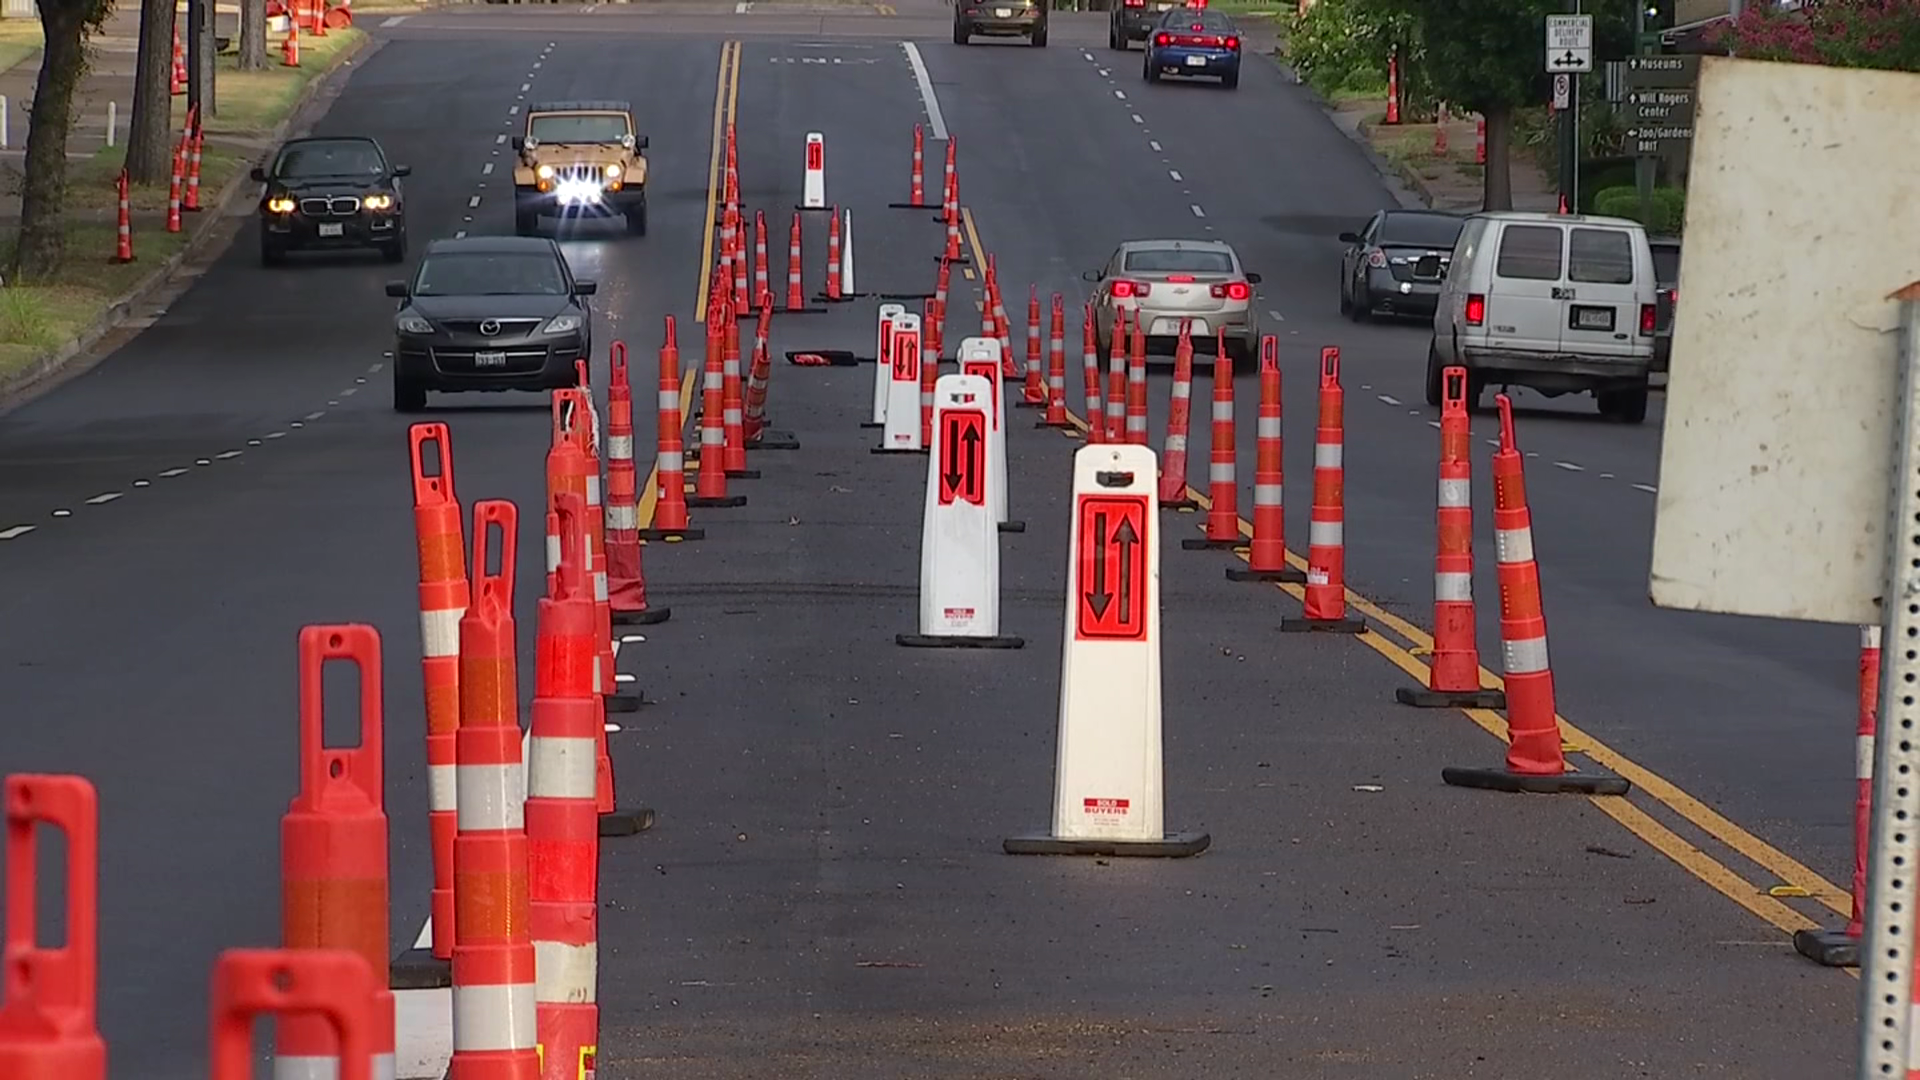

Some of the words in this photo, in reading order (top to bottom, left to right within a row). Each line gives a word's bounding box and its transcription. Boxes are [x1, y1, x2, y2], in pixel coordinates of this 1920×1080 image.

[1554, 28, 1584, 37] DELIVERY
[1639, 59, 1683, 69] Museums
[1639, 93, 1656, 103] Will
[1658, 93, 1689, 106] Rogers
[1638, 106, 1670, 117] Center
[1638, 127, 1693, 139] Zoo/Gardens
[1638, 141, 1657, 151] BRIT
[1084, 807, 1128, 815] BUYERS
